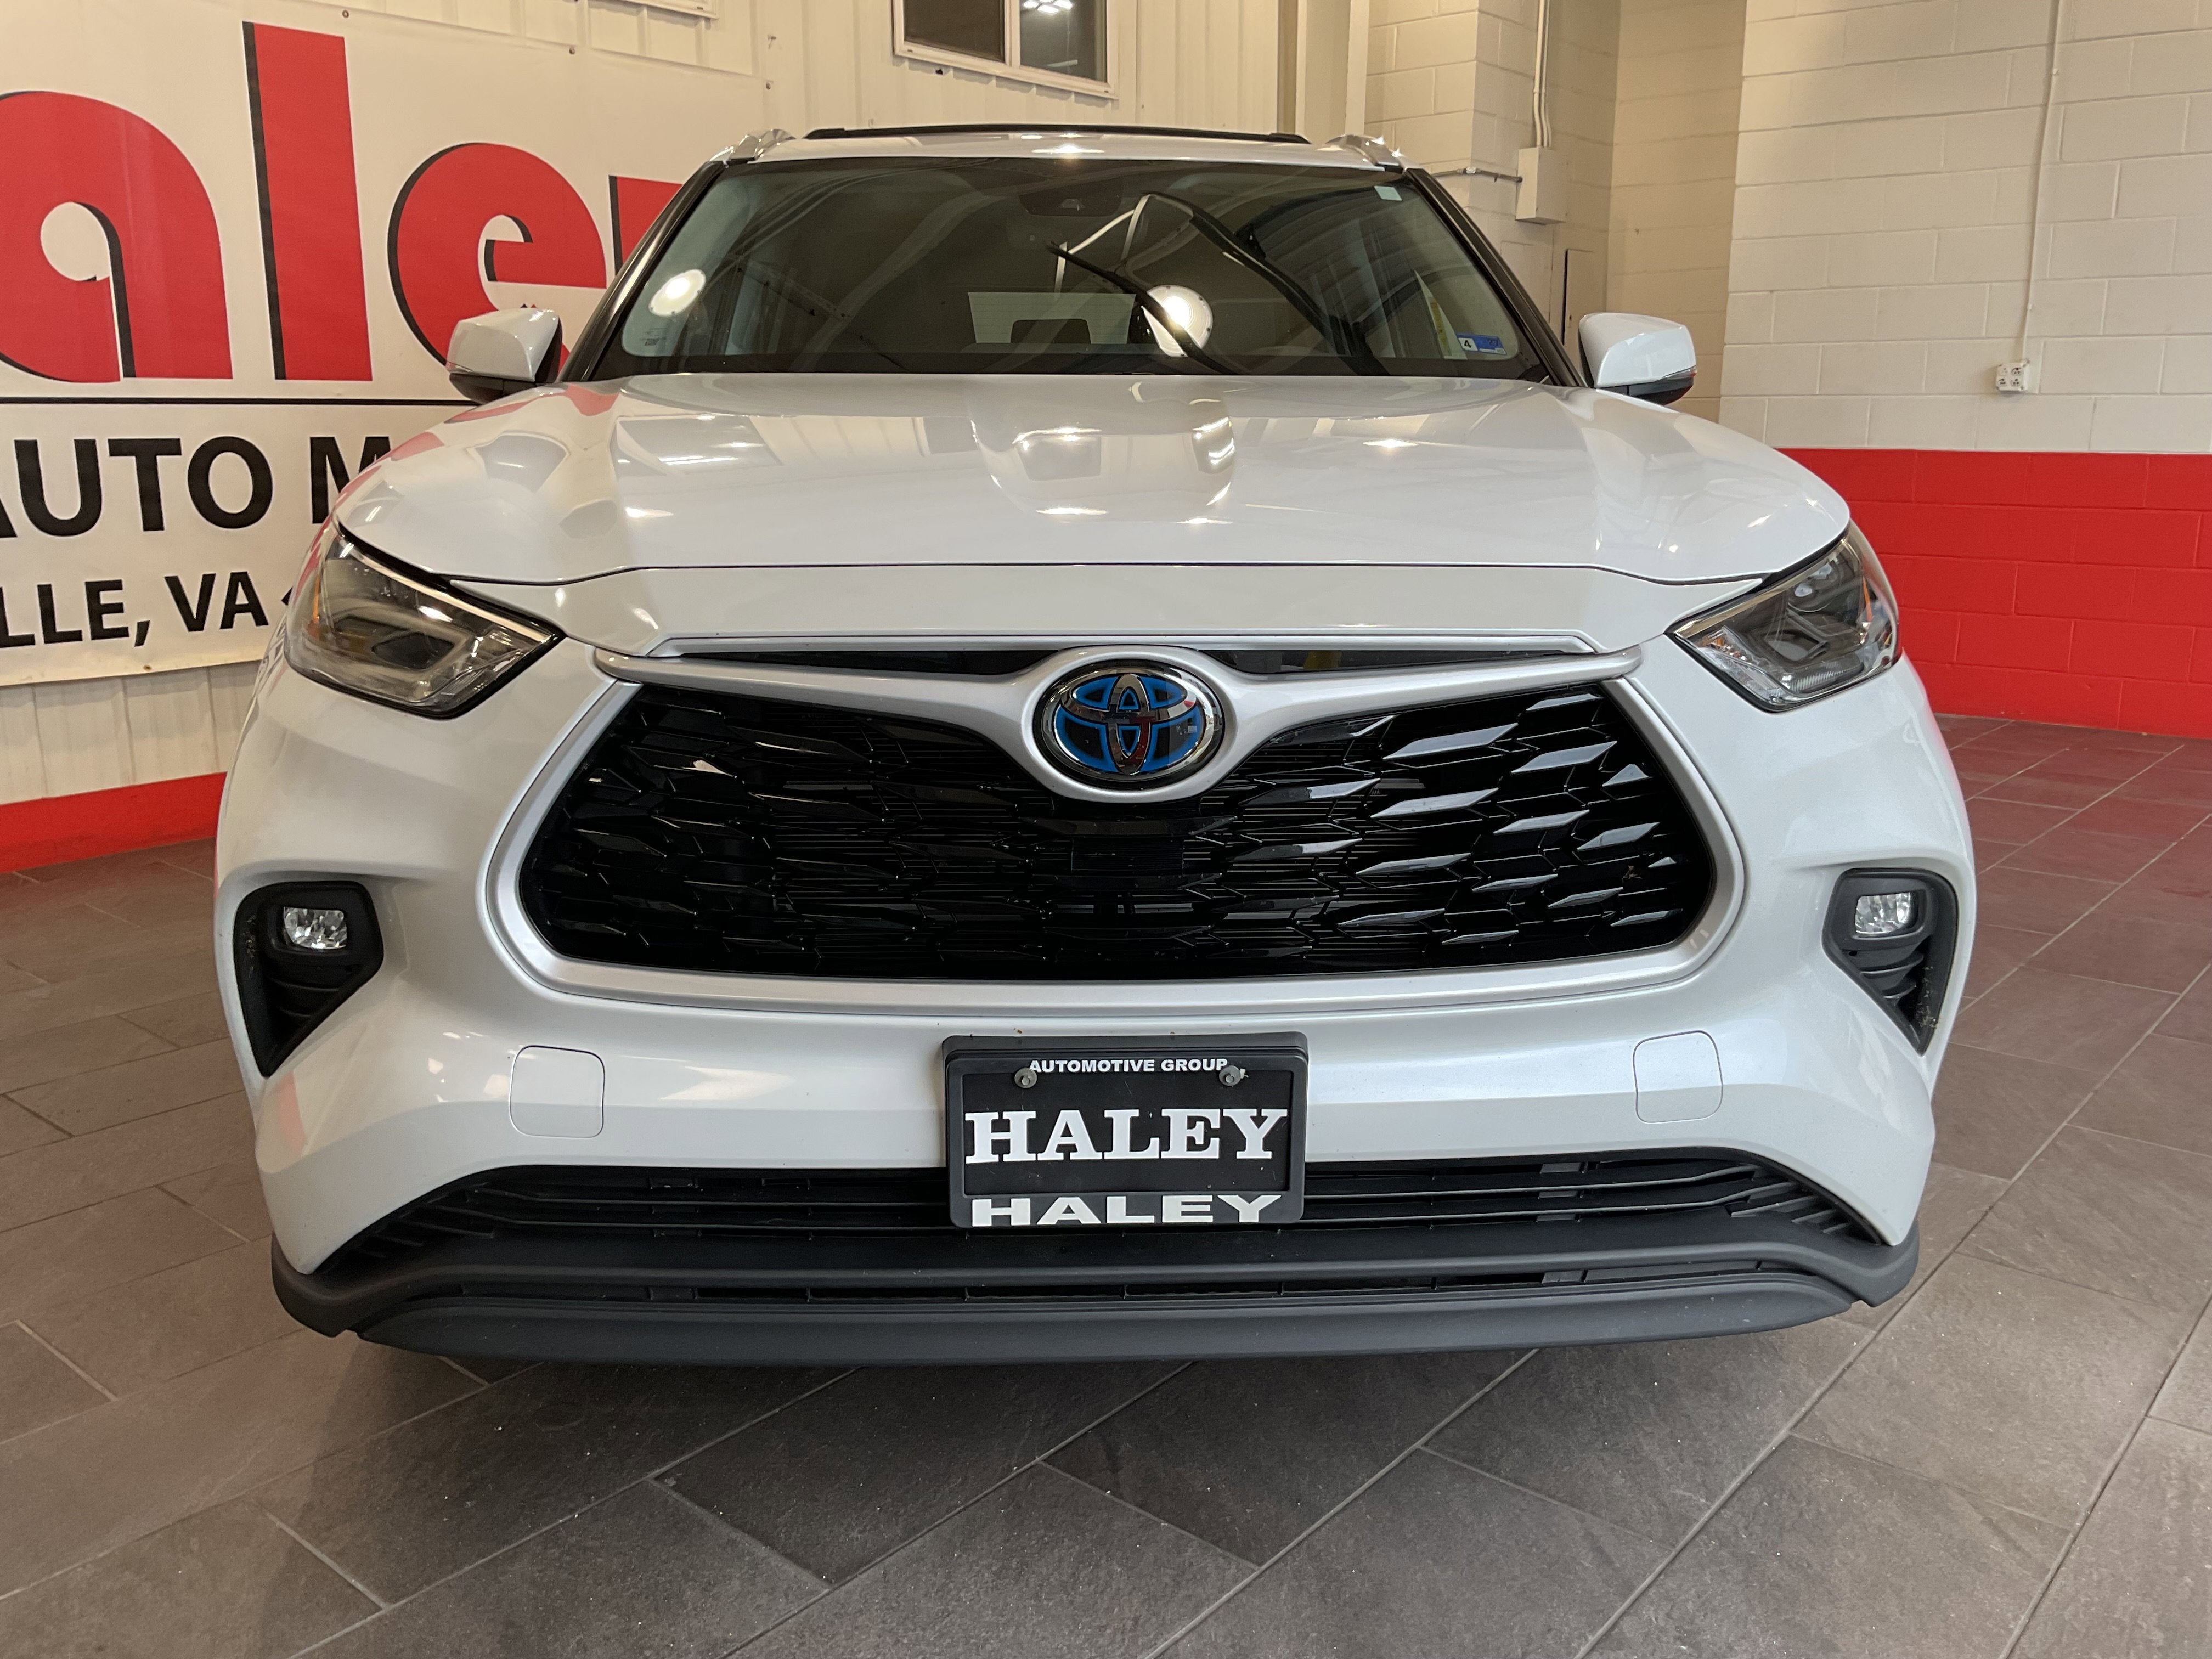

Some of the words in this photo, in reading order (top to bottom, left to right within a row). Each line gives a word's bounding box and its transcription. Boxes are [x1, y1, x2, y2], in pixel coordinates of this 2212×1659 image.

[0, 21, 682, 383] ale
[0, 436, 273, 538] UTO
[164, 571, 269, 632] VA
[1029, 1059, 1155, 1073] AUTOMOTIVE
[1160, 1058, 1228, 1071] GROUP
[964, 1108, 1288, 1164] HALEY
[972, 1194, 1282, 1227] HALEY
